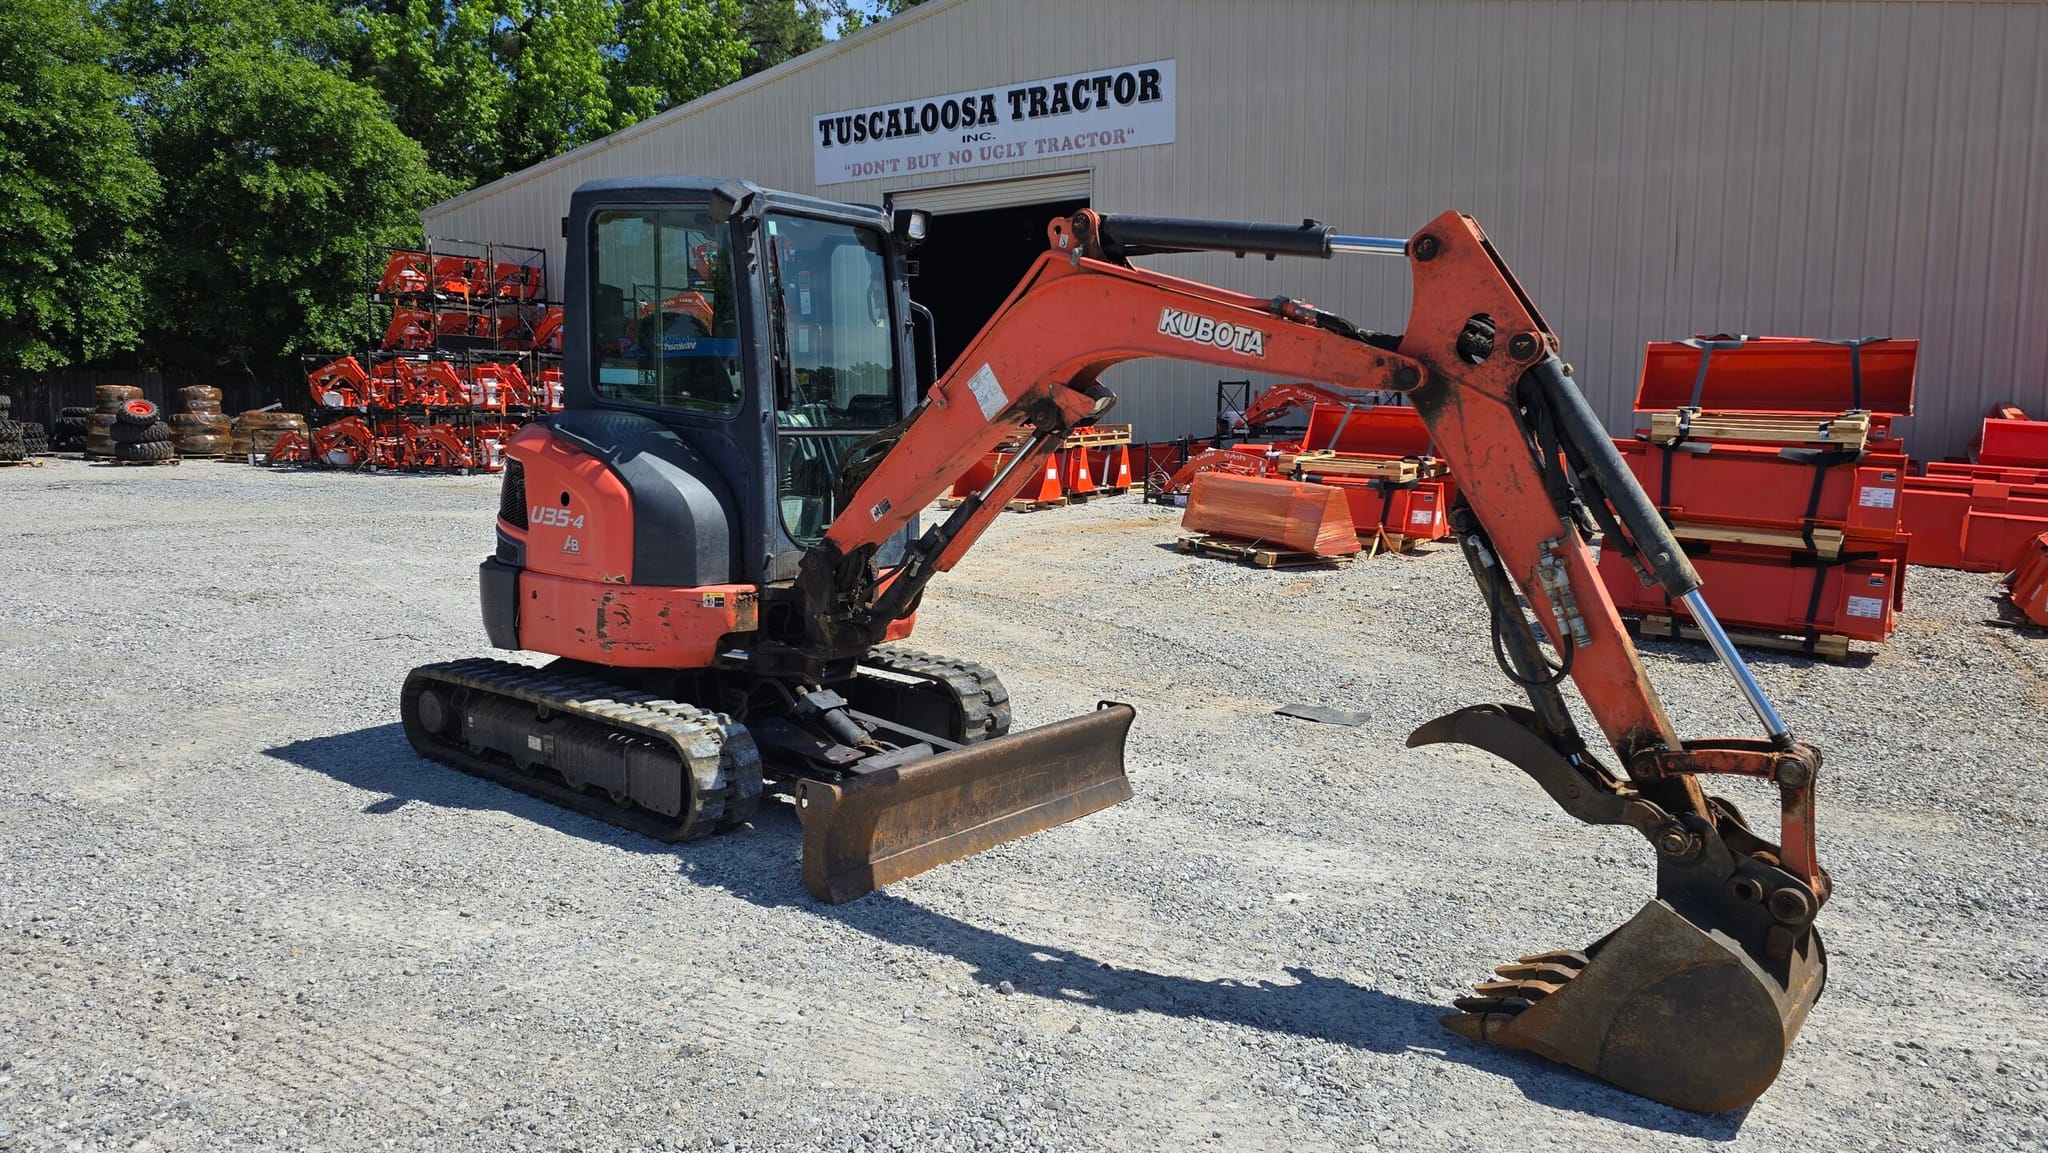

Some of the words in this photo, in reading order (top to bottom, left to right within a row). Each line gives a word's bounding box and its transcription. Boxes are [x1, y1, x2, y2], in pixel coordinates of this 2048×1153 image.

[819, 93, 997, 147] TUSCALOOSA
[1008, 68, 1161, 120] TRACTOR
[962, 132, 996, 143] INC.
[907, 153, 941, 170] BUY
[949, 149, 973, 165] NO
[980, 141, 1027, 161] UGLY
[1159, 308, 1264, 356] KUBOTA
[530, 505, 585, 529] U35-4
